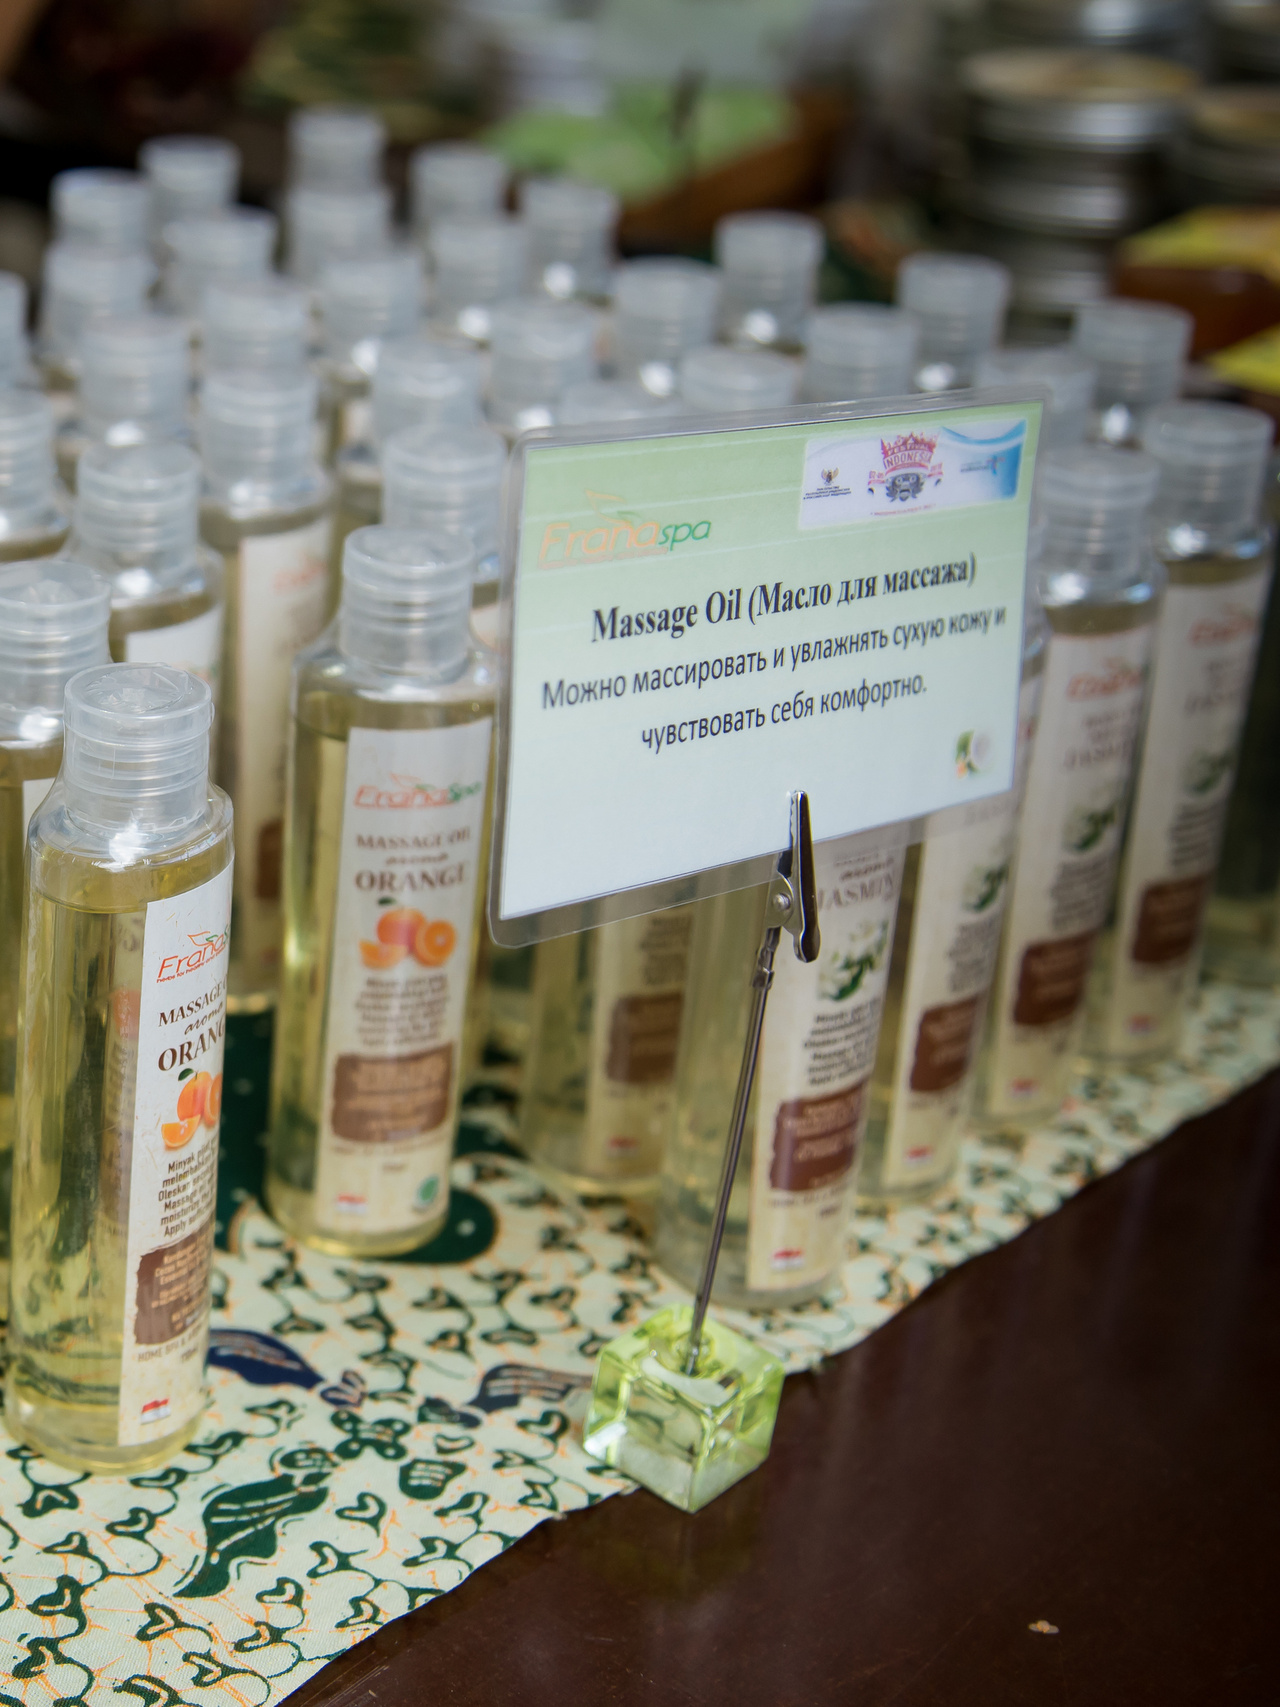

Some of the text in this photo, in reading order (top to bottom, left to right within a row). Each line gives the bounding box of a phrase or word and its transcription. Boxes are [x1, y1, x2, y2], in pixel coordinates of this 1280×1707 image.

[591, 552, 977, 643] Massage Oil (Масло для массажа)
[542, 606, 1007, 710] Можно массировать и увлажнять сухую кожу и
[641, 674, 927, 755] чувствовать себя комфортно.
[354, 862, 470, 892] ORANGE
